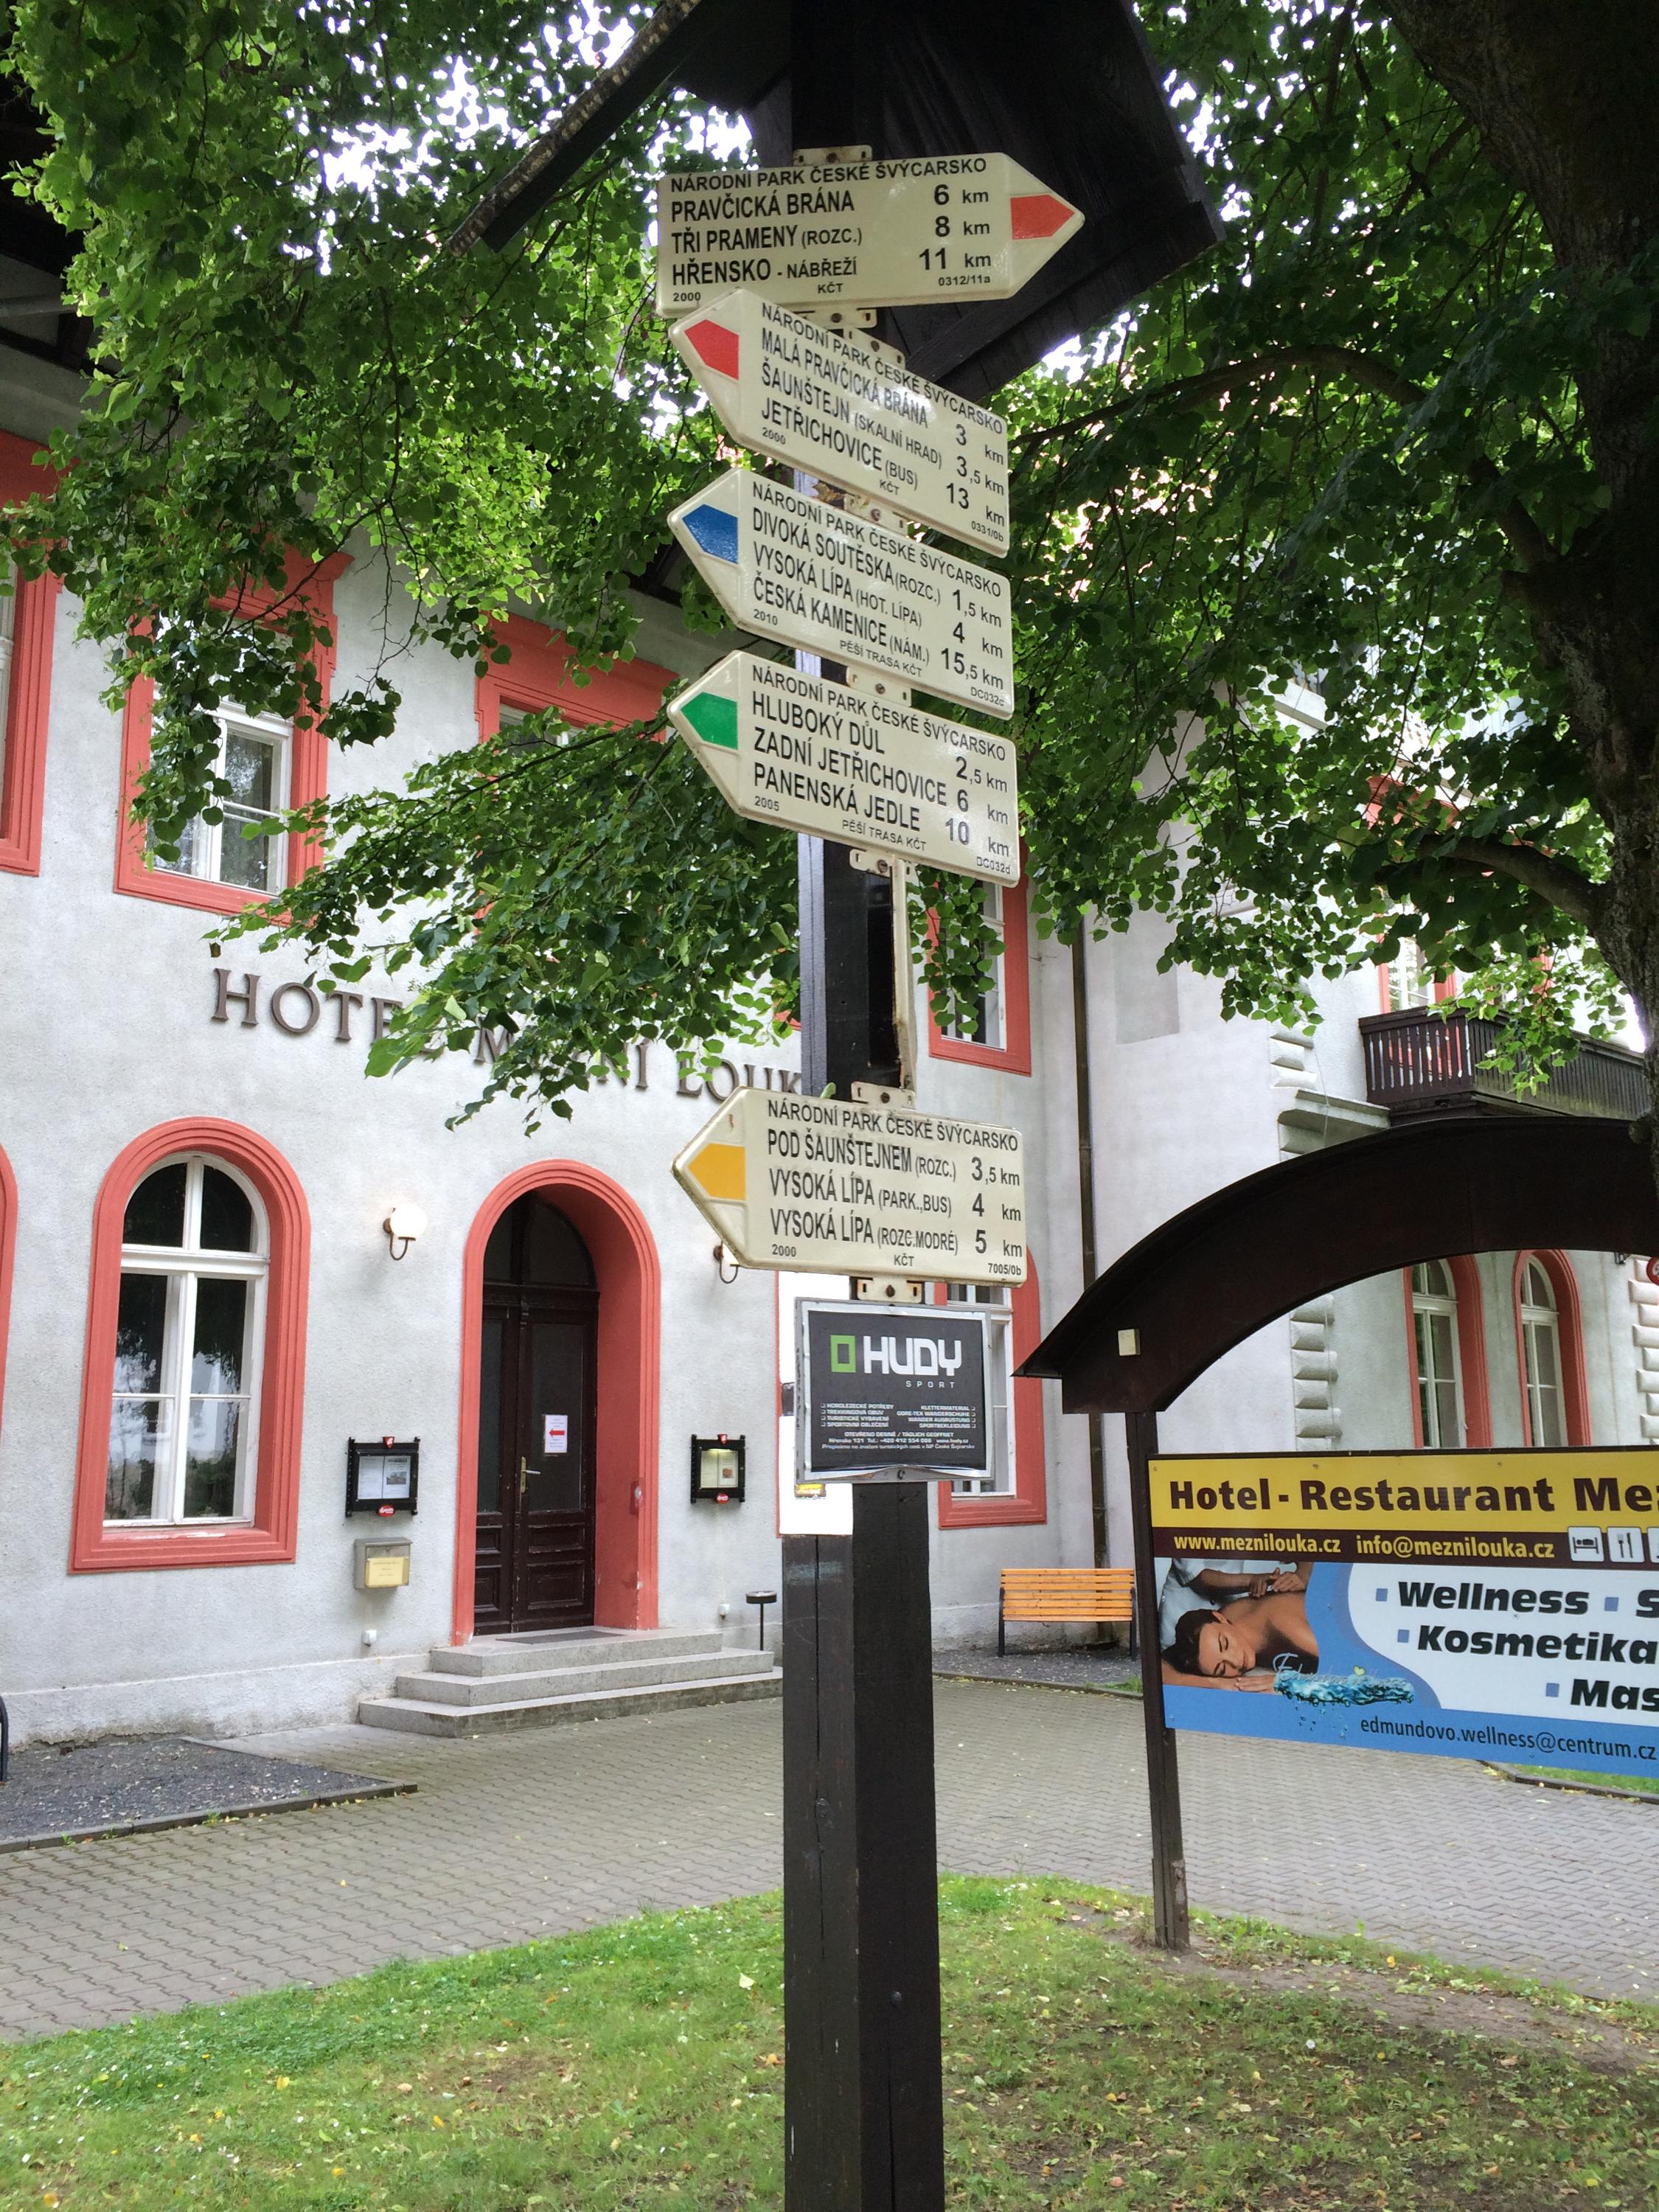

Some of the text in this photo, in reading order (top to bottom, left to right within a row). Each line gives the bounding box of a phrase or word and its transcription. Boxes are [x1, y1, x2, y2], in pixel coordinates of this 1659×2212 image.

[671, 158, 986, 192] NÁRODNÍ PARK ČESKÉ ŠVÝCARSKO
[672, 184, 989, 223] PRAVČICKÁ BRÁNA 6 km
[672, 216, 990, 254] TŘI PRAMENY (ROZC.) 8 km
[673, 258, 771, 285] HŘENSKO
[787, 257, 857, 278] NÁBŘEŽÍ
[919, 248, 946, 270] 11
[965, 253, 991, 268] km
[939, 274, 990, 286] 0312/11a
[673, 291, 702, 302] 2000
[818, 282, 844, 293] KČT
[762, 302, 1002, 434] NÁRODNÍ PARK ČESKÉ ŠVÝCARSKO
[762, 327, 1004, 465] MALÁ PRAVČICKÁ BRÁNA 3 km
[762, 362, 1004, 495] ŠAUNŠTEJN (SKALNÍ HRAD) 3,5 km
[762, 427, 785, 445] 2000
[762, 397, 1004, 526] JETŘICHOVICE (BUS) 13 km
[880, 479, 900, 495] KČT
[754, 481, 1001, 597] NÁRODNÍ PARK ČESKÉ ŠVÝCARSKO
[971, 521, 1004, 542] 0331/0b
[754, 507, 1001, 627] DIVOKÁ SOUTĚSKA (ROZC.) 1,5 km
[754, 541, 1003, 658] VYSOKÁ LÍPA (HOT. LÍPA) 4 km
[754, 609, 778, 625] 2010
[754, 577, 1003, 689] ČESKÁ KAMENICE (NÁM.) 15,5 km
[840, 640, 922, 677] PĚŠÍ TRASA KČT
[753, 665, 1005, 761] NÁRODNÍ PARK ČESKÉ ŠVÝCARSKO
[971, 686, 1004, 706] DC032c
[753, 691, 1007, 793] HLUBOKÝ DŮL 2,5 km
[754, 726, 1008, 824] ZADNÍ JETŘICHOVICE 6 km
[755, 796, 779, 811] 2005
[755, 762, 1009, 857] PANENSKÁ JEDLE 10 km
[843, 820, 926, 851] PĚŠÍ TRASA KČT
[977, 856, 1010, 874] DC032d
[212, 967, 445, 1055] HOTE
[768, 1099, 1018, 1151] NÁRODNÍ PARK ČESKÉ ŠVÝCARSKO
[768, 1127, 1020, 1186] POD ŠAUNŠTEJNEM (ROZC.) 3,5 km
[769, 1169, 837, 1201] VYSOKÁ
[841, 1172, 874, 1205] LÍPA
[973, 1193, 984, 1217] 4
[1002, 1204, 1020, 1221] km
[771, 1208, 837, 1240] VYSOKÁ
[841, 1210, 874, 1243] LÍPA
[975, 1229, 987, 1253] 5
[1004, 1239, 1022, 1257] km
[772, 1244, 796, 1257] 2000
[894, 1253, 914, 1267] KČT
[988, 1263, 1021, 1276] 7005/0b
[863, 1336, 961, 1376] HUDY
[1170, 1478, 1270, 1510] Hotel
[1300, 1478, 1555, 1512] Restaurant
[1573, 1478, 1659, 1512] Me
[1174, 1534, 1554, 1558] www.meznilouka.cz info@meznilouka.cz
[1399, 1582, 1589, 1615] Wellness
[1418, 1625, 1658, 1664] Kosmetika
[1360, 1717, 1657, 1760] edmundovo.wellness@centrum.cz
